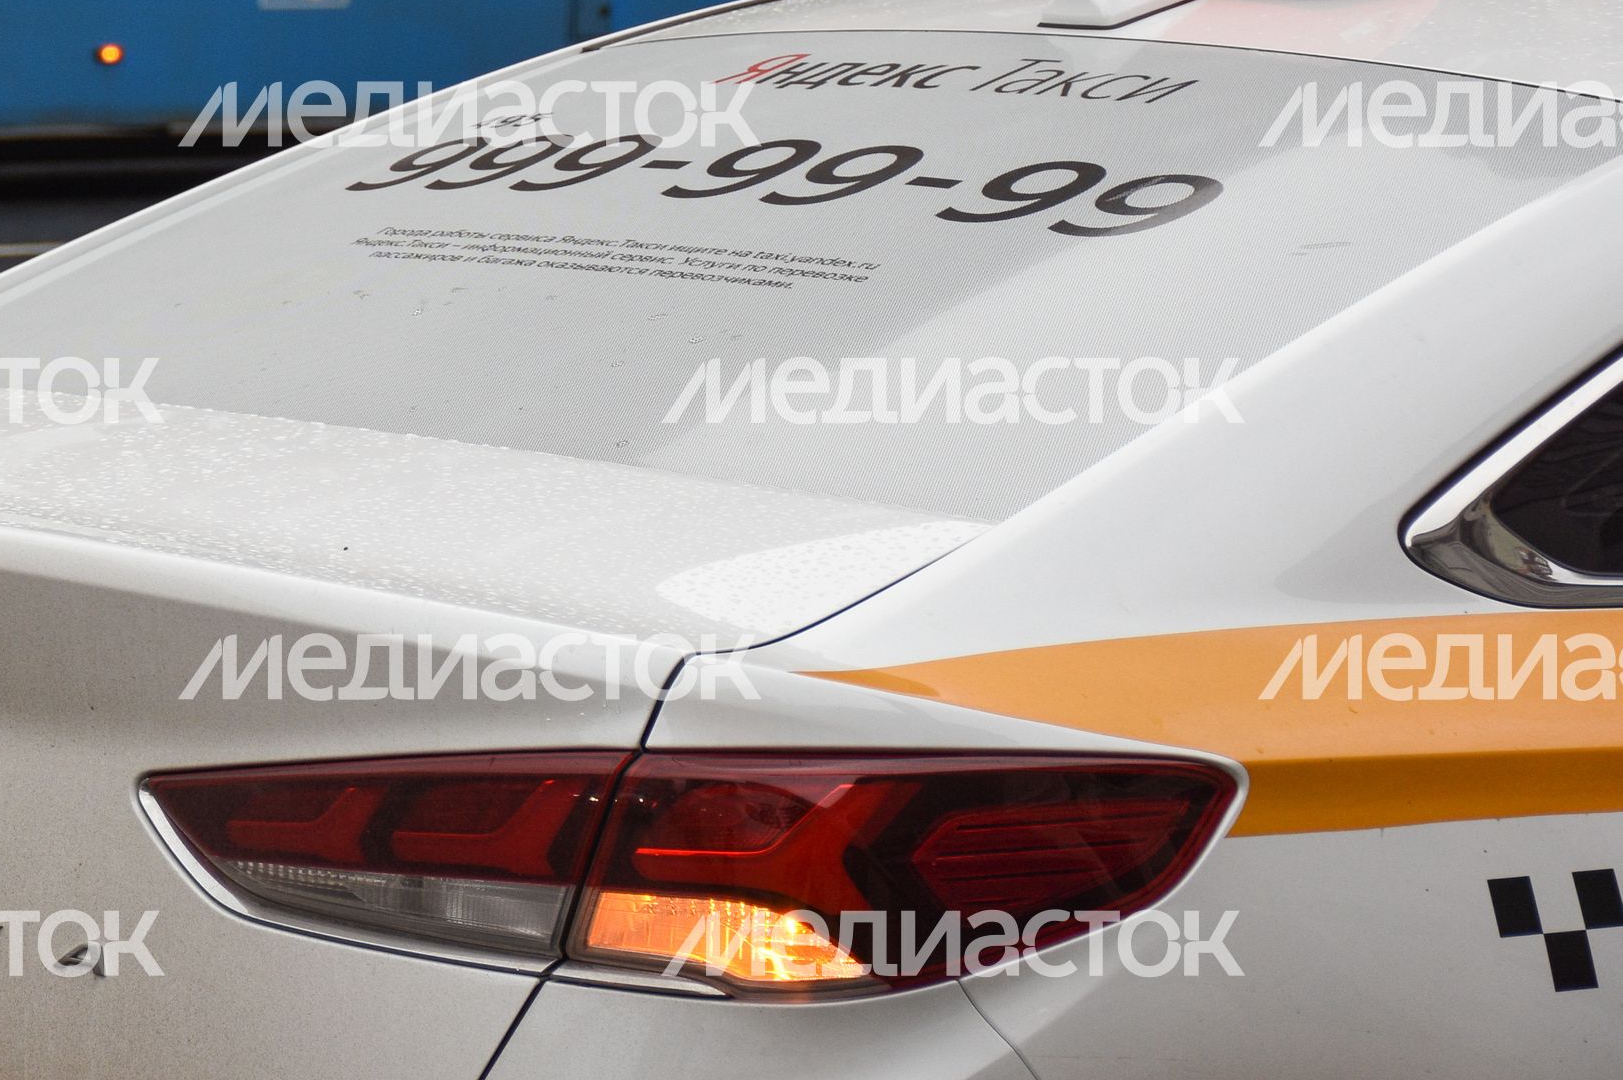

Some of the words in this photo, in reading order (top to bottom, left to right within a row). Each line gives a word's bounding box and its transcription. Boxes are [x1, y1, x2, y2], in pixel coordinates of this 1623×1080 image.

[710, 53, 980, 90] Яндекс
[971, 58, 1199, 103] Такси
[345, 134, 1224, 237] 999-99-99
[368, 250, 464, 263] пассажиров
[476, 254, 537, 267] багажа
[536, 260, 651, 276] оказываются
[377, 226, 432, 239] Города
[427, 229, 491, 240] работы
[489, 232, 557, 243] сервиса
[668, 243, 728, 255] ищите
[727, 249, 753, 258] на
[752, 252, 881, 270] taxi.yandex.ru
[461, 243, 613, 260] информационный
[678, 256, 743, 271] Услуги
[741, 263, 768, 273] по
[766, 266, 869, 283] перевозке
